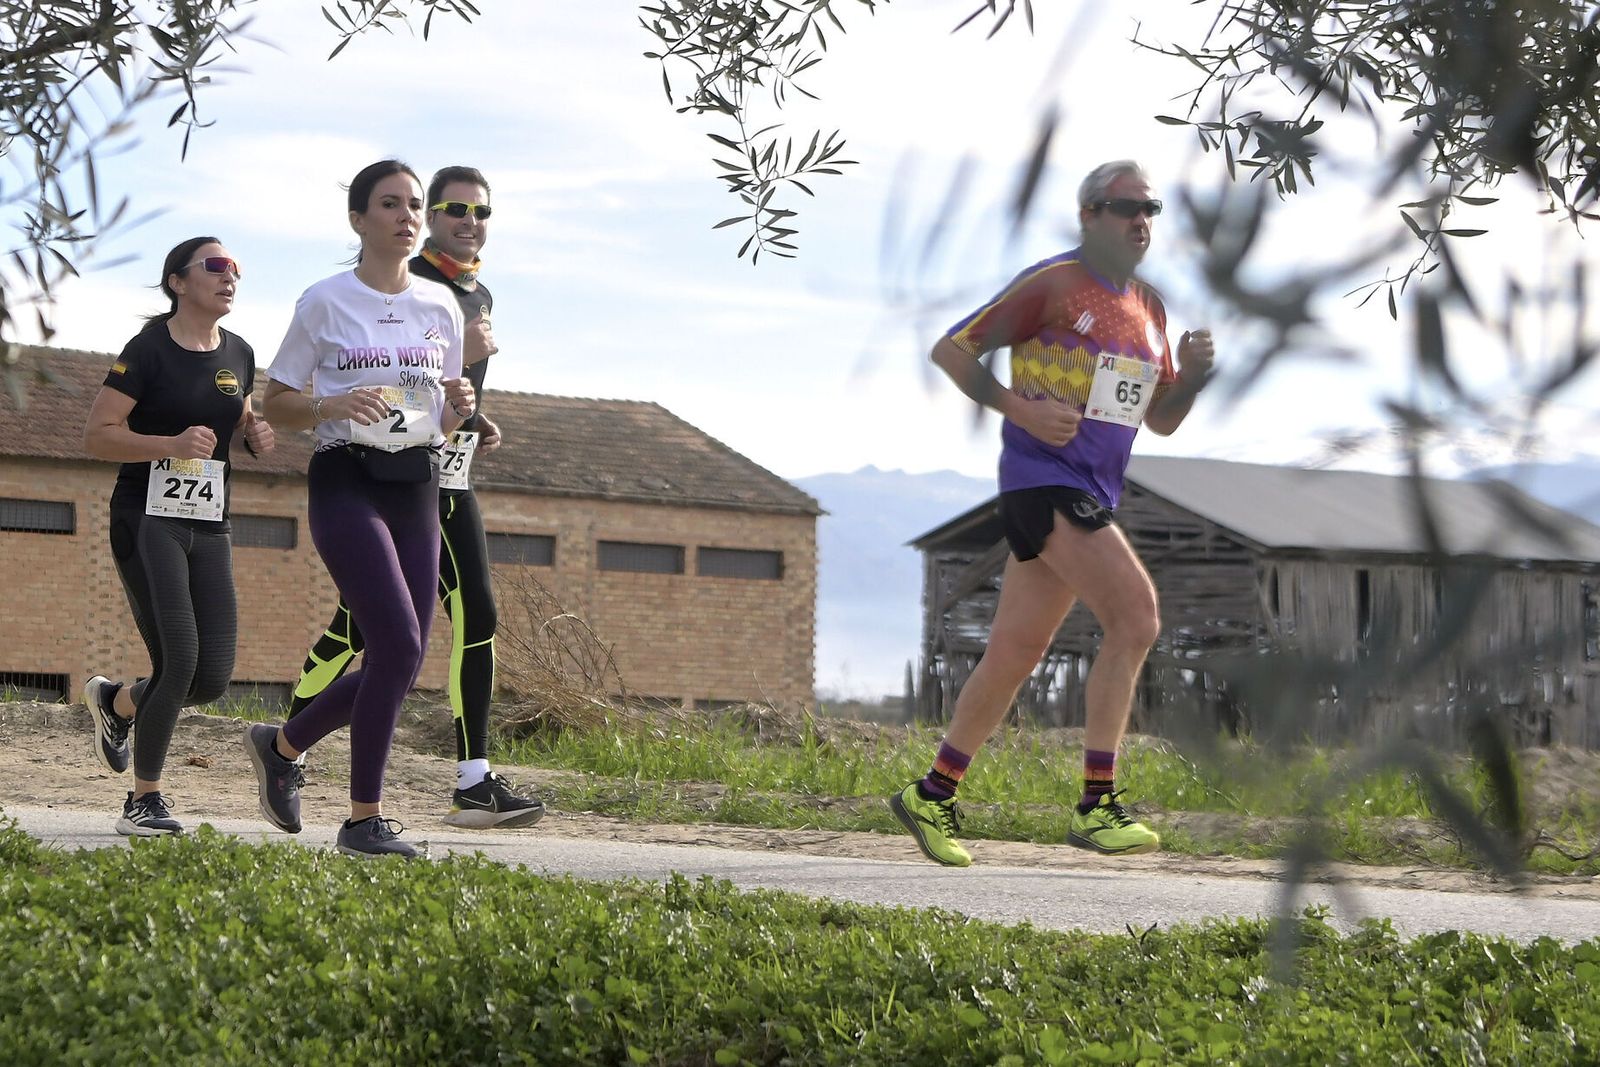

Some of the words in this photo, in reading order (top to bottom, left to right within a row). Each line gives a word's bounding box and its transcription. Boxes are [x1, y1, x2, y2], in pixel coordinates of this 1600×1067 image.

[337, 347, 391, 371] CARAS
[398, 370, 420, 390] Sky
[404, 390, 415, 401] 28
[1115, 380, 1142, 406] 65
[388, 409, 408, 433] 2
[154, 457, 171, 471] XI
[162, 477, 214, 502] 274
